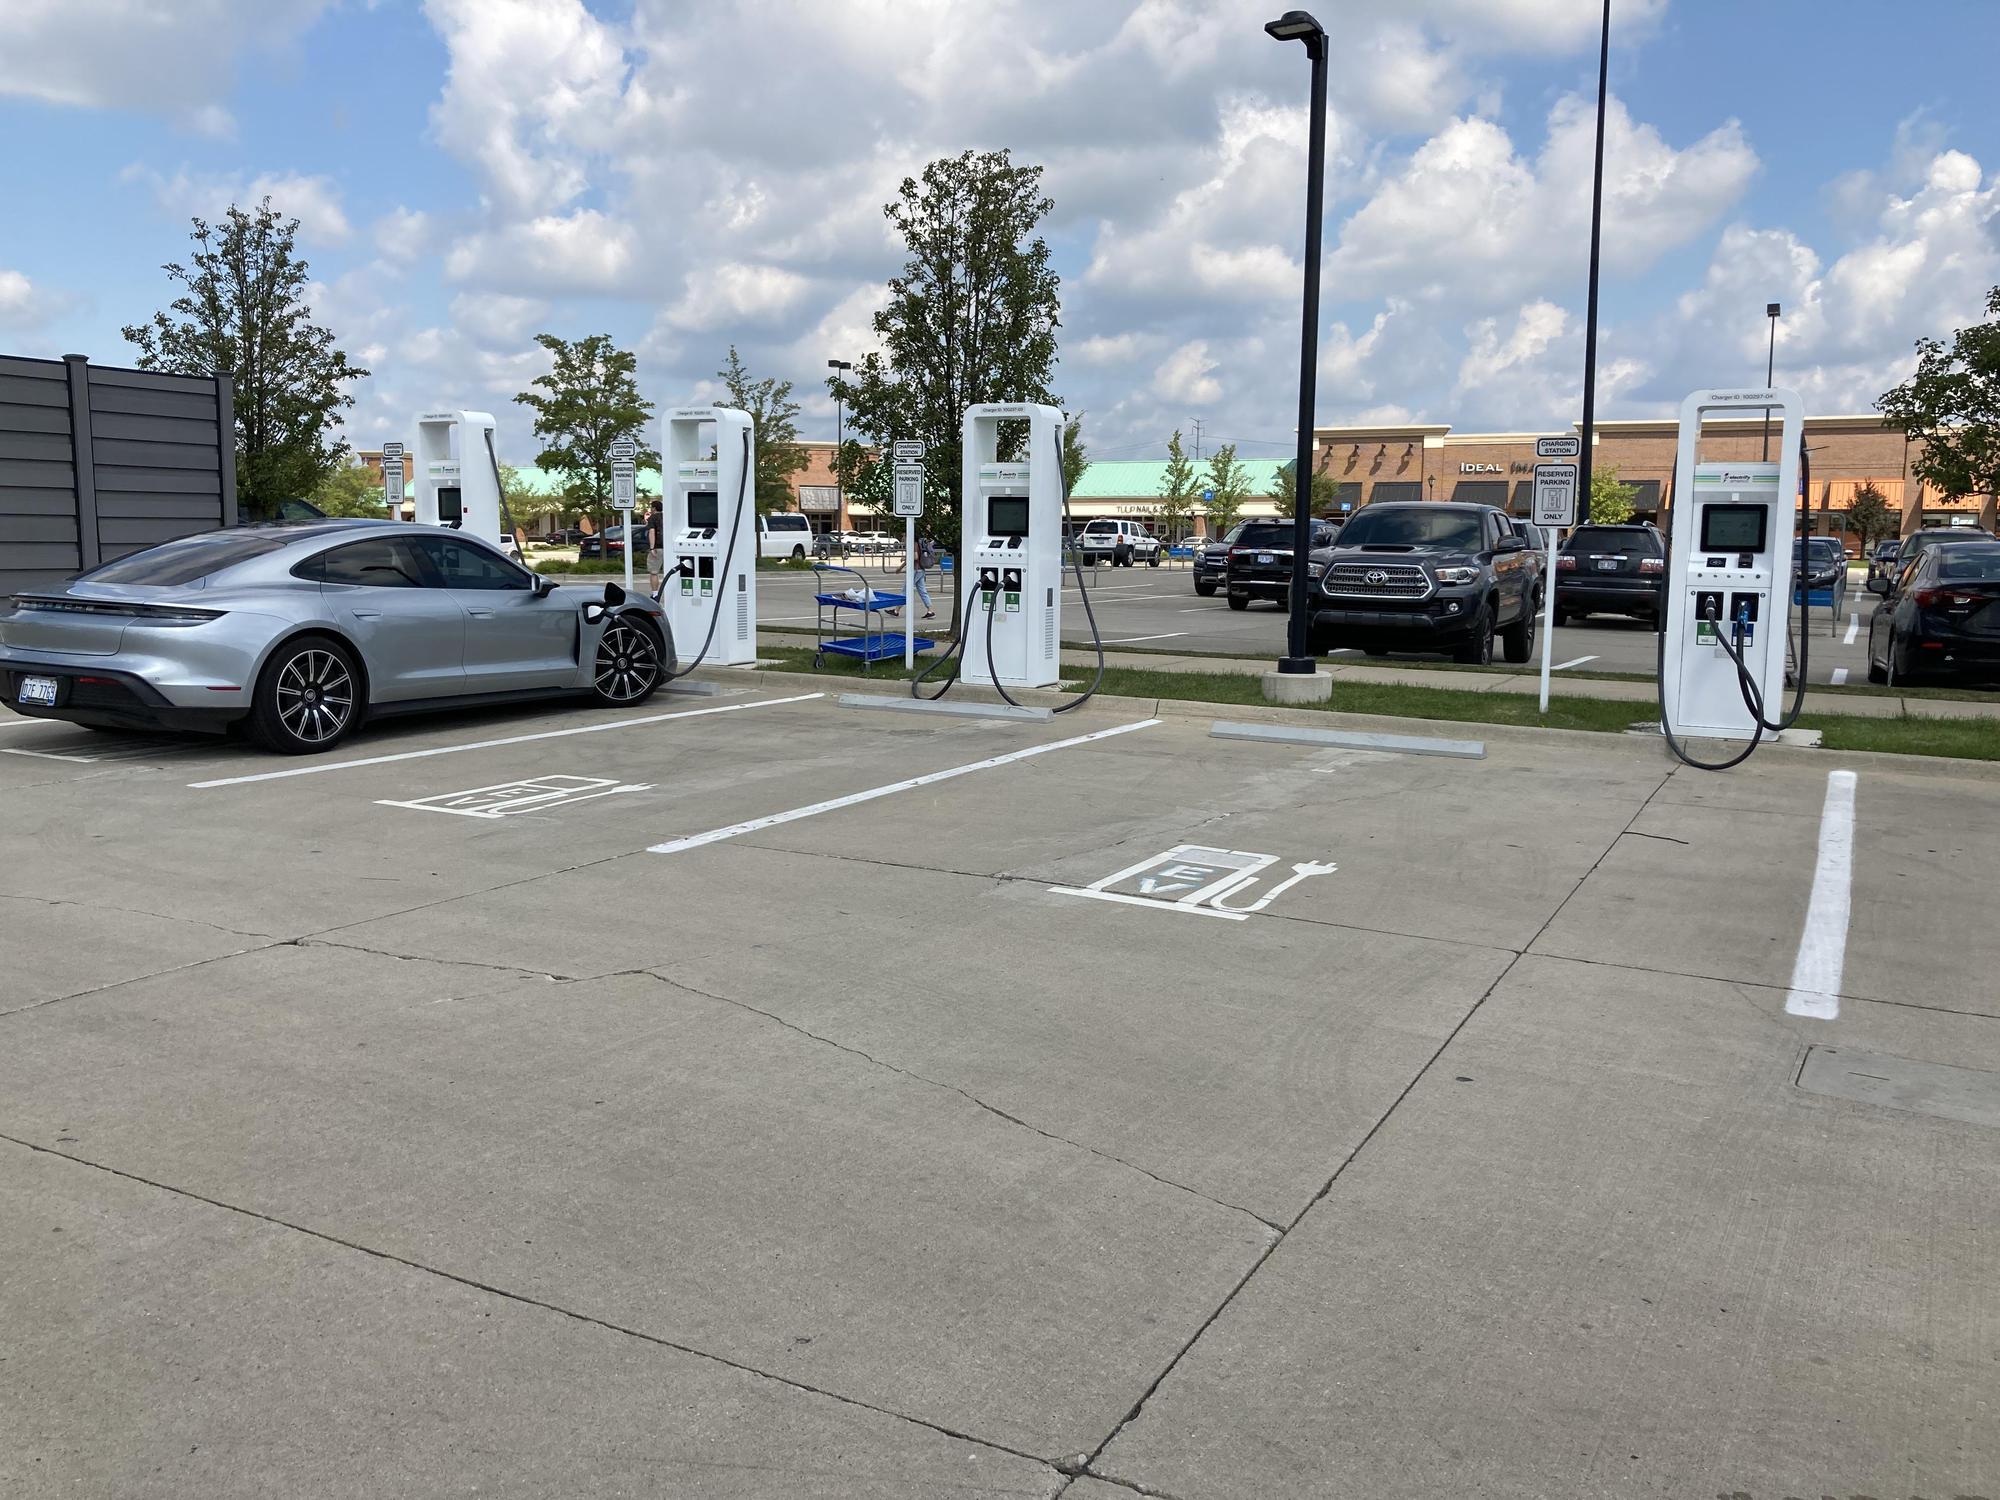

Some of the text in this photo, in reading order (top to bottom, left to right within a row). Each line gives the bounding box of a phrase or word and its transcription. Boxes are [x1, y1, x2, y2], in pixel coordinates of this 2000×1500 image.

[1460, 462, 1504, 472] IDEAL
[1537, 470, 1574, 478] RESERVED
[1152, 505, 1158, 513] &
